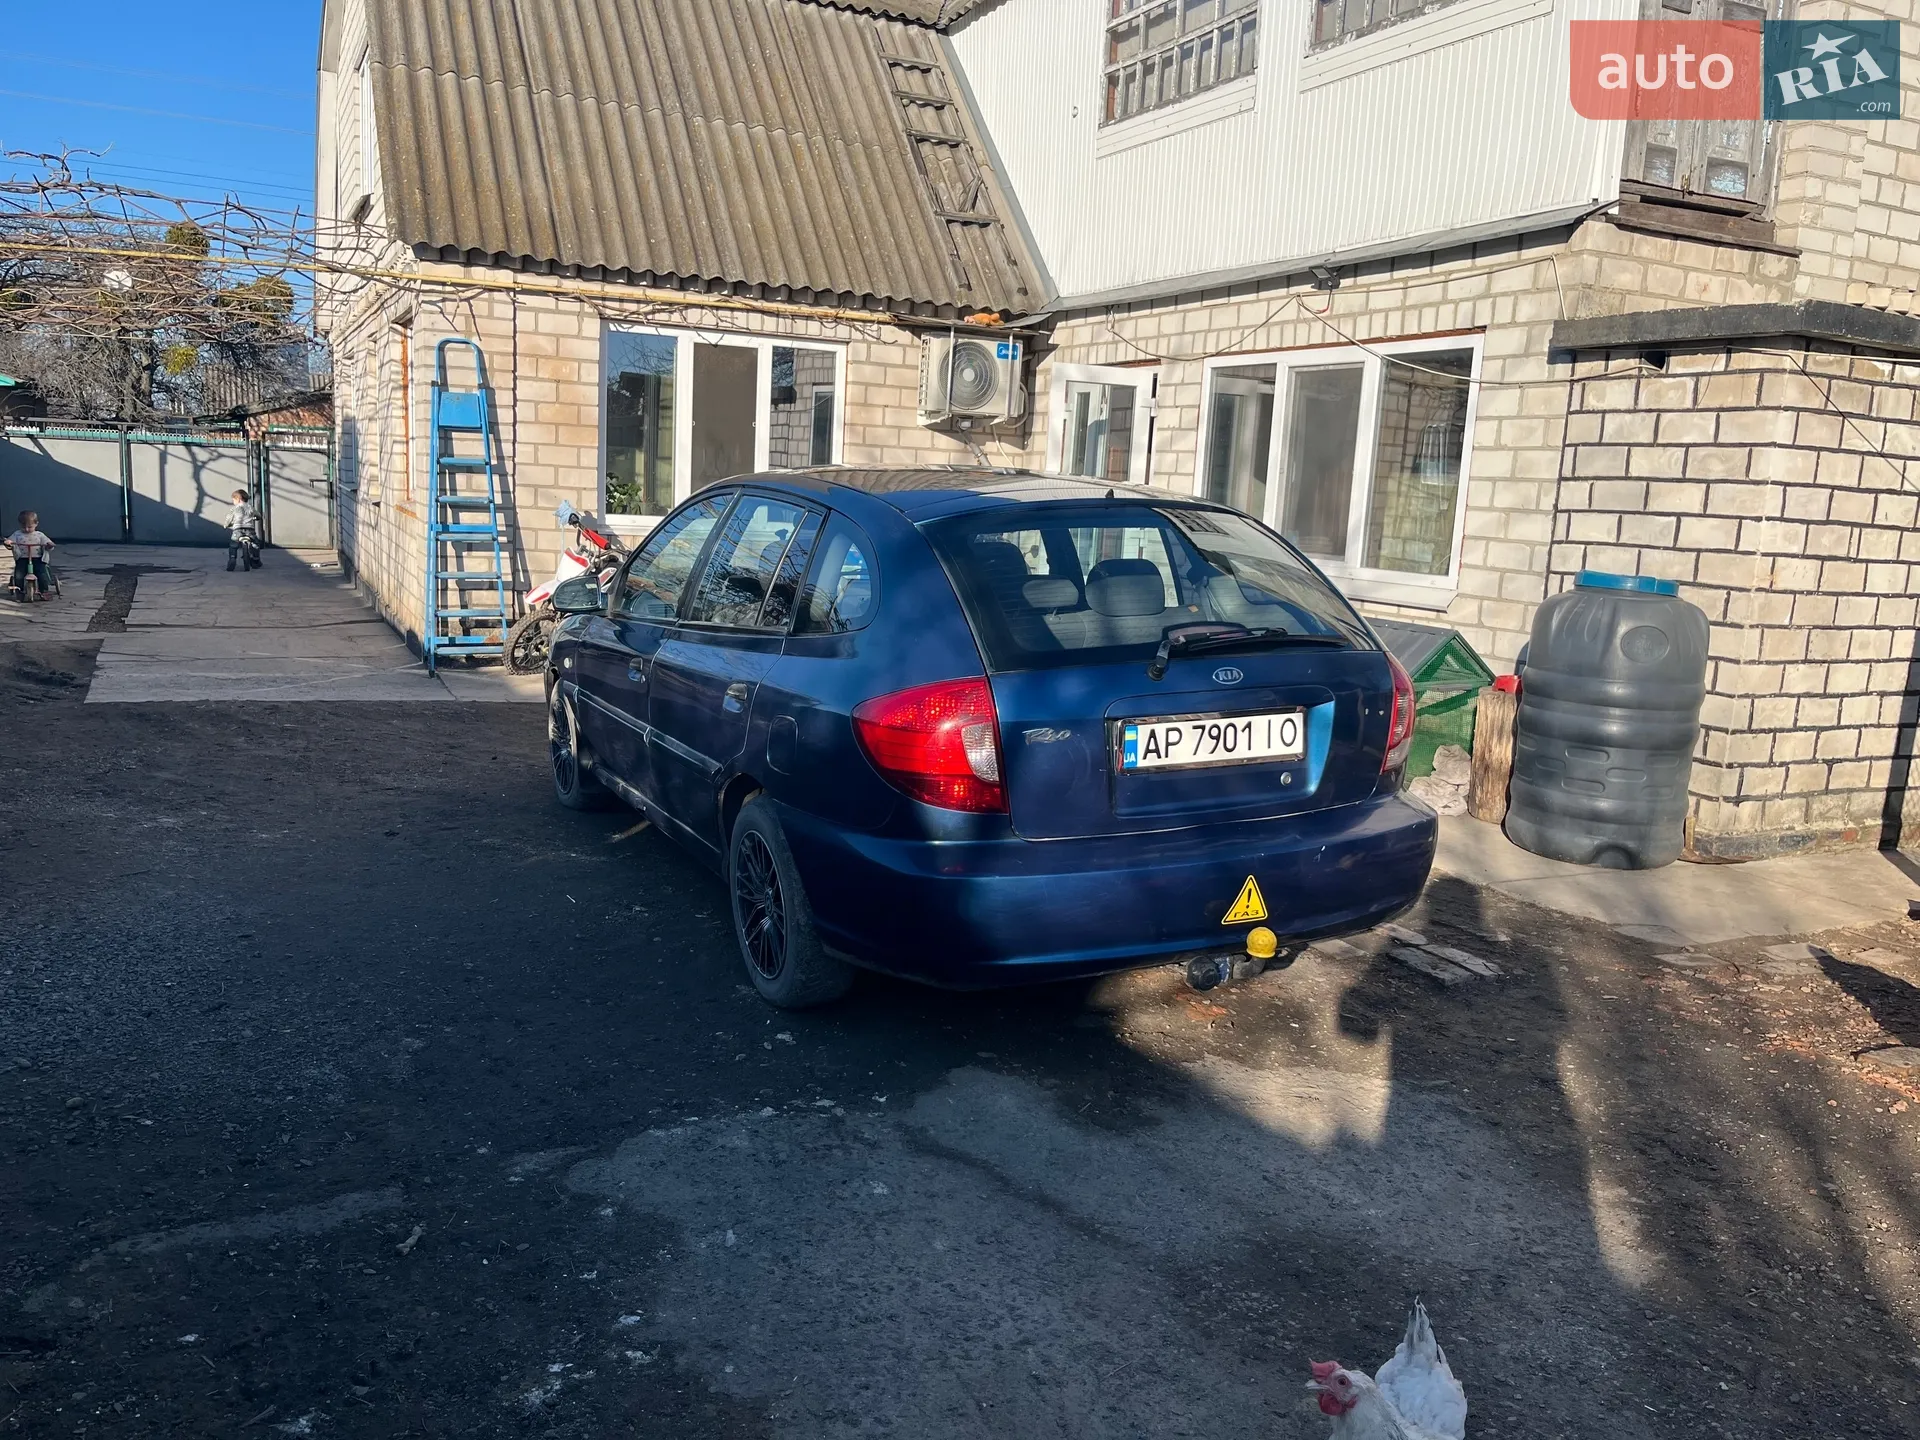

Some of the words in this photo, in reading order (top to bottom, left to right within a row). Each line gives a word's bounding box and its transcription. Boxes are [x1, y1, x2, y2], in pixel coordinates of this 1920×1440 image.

[1218, 670, 1240, 680] KIA
[1143, 727, 1183, 760] AP
[1191, 721, 1252, 756] 7901
[1124, 752, 1136, 763] UA
[1233, 909, 1260, 918] ГАЗ
